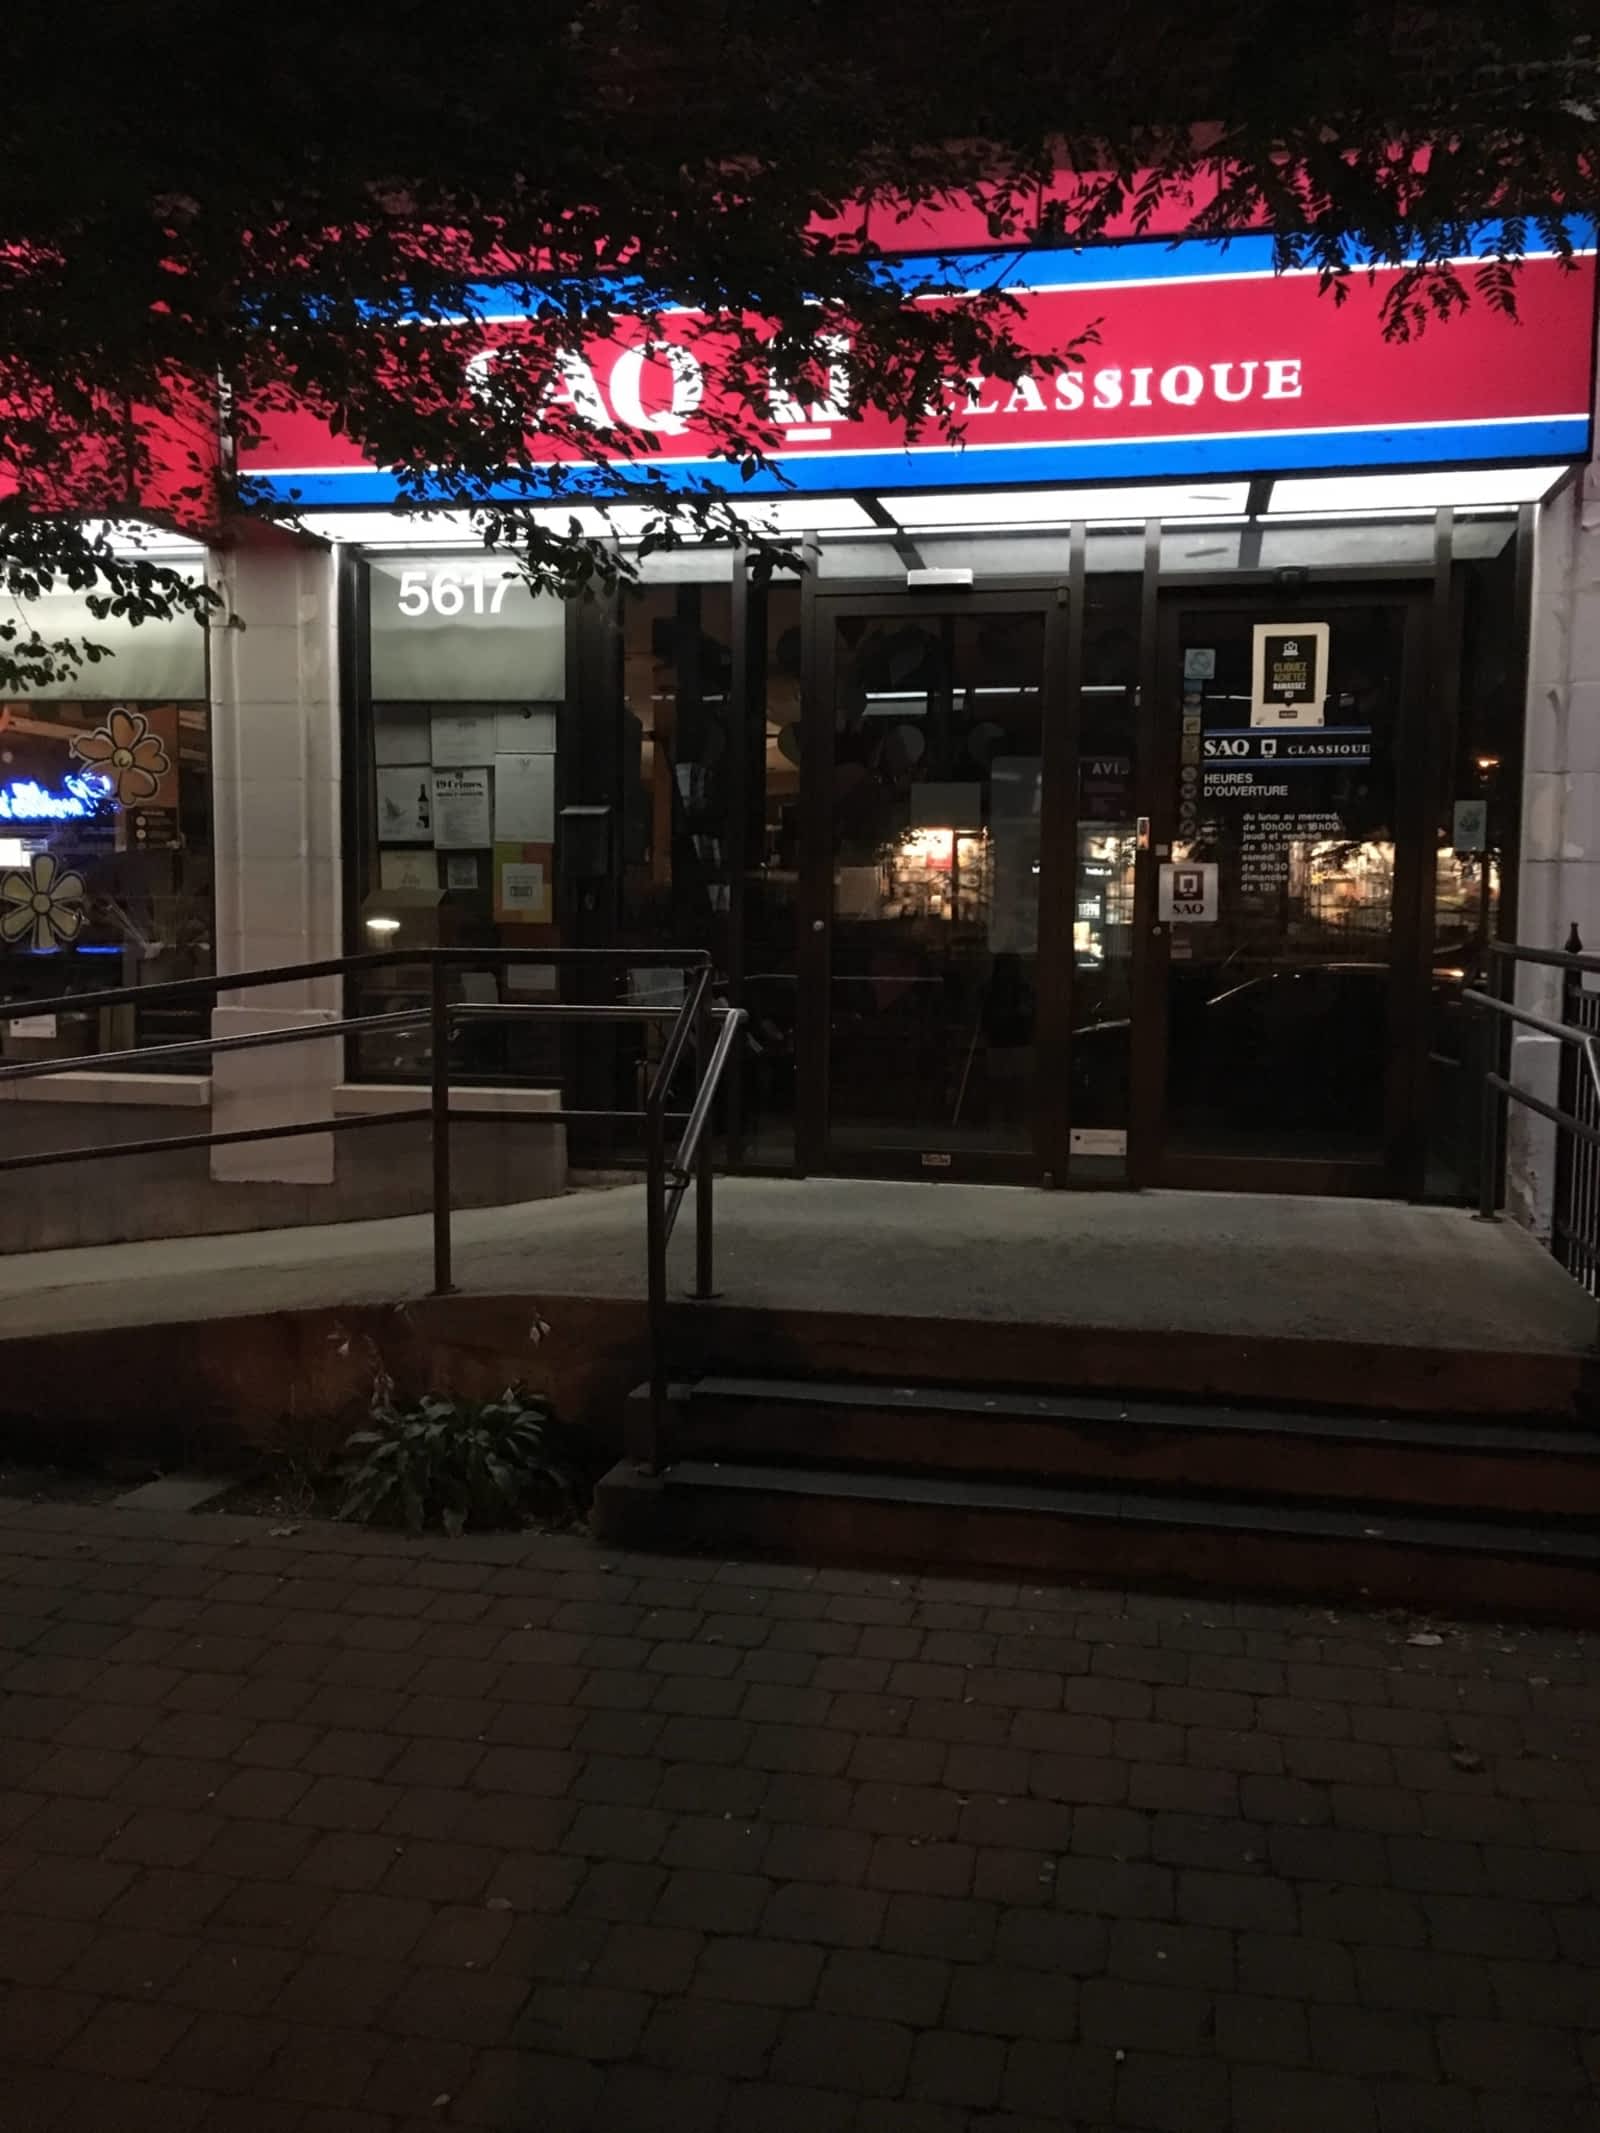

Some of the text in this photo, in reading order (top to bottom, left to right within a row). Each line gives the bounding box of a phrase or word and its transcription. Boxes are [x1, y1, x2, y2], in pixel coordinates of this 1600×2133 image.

[922, 359, 1303, 417] CLASSIQUE
[398, 568, 514, 616] 5617
[1203, 739, 1371, 756] SAQ CLASSIQUE
[1203, 773, 1254, 784] HEURES
[1203, 785, 1289, 797] D'OUVERTURE
[1173, 903, 1205, 915] SAQ
